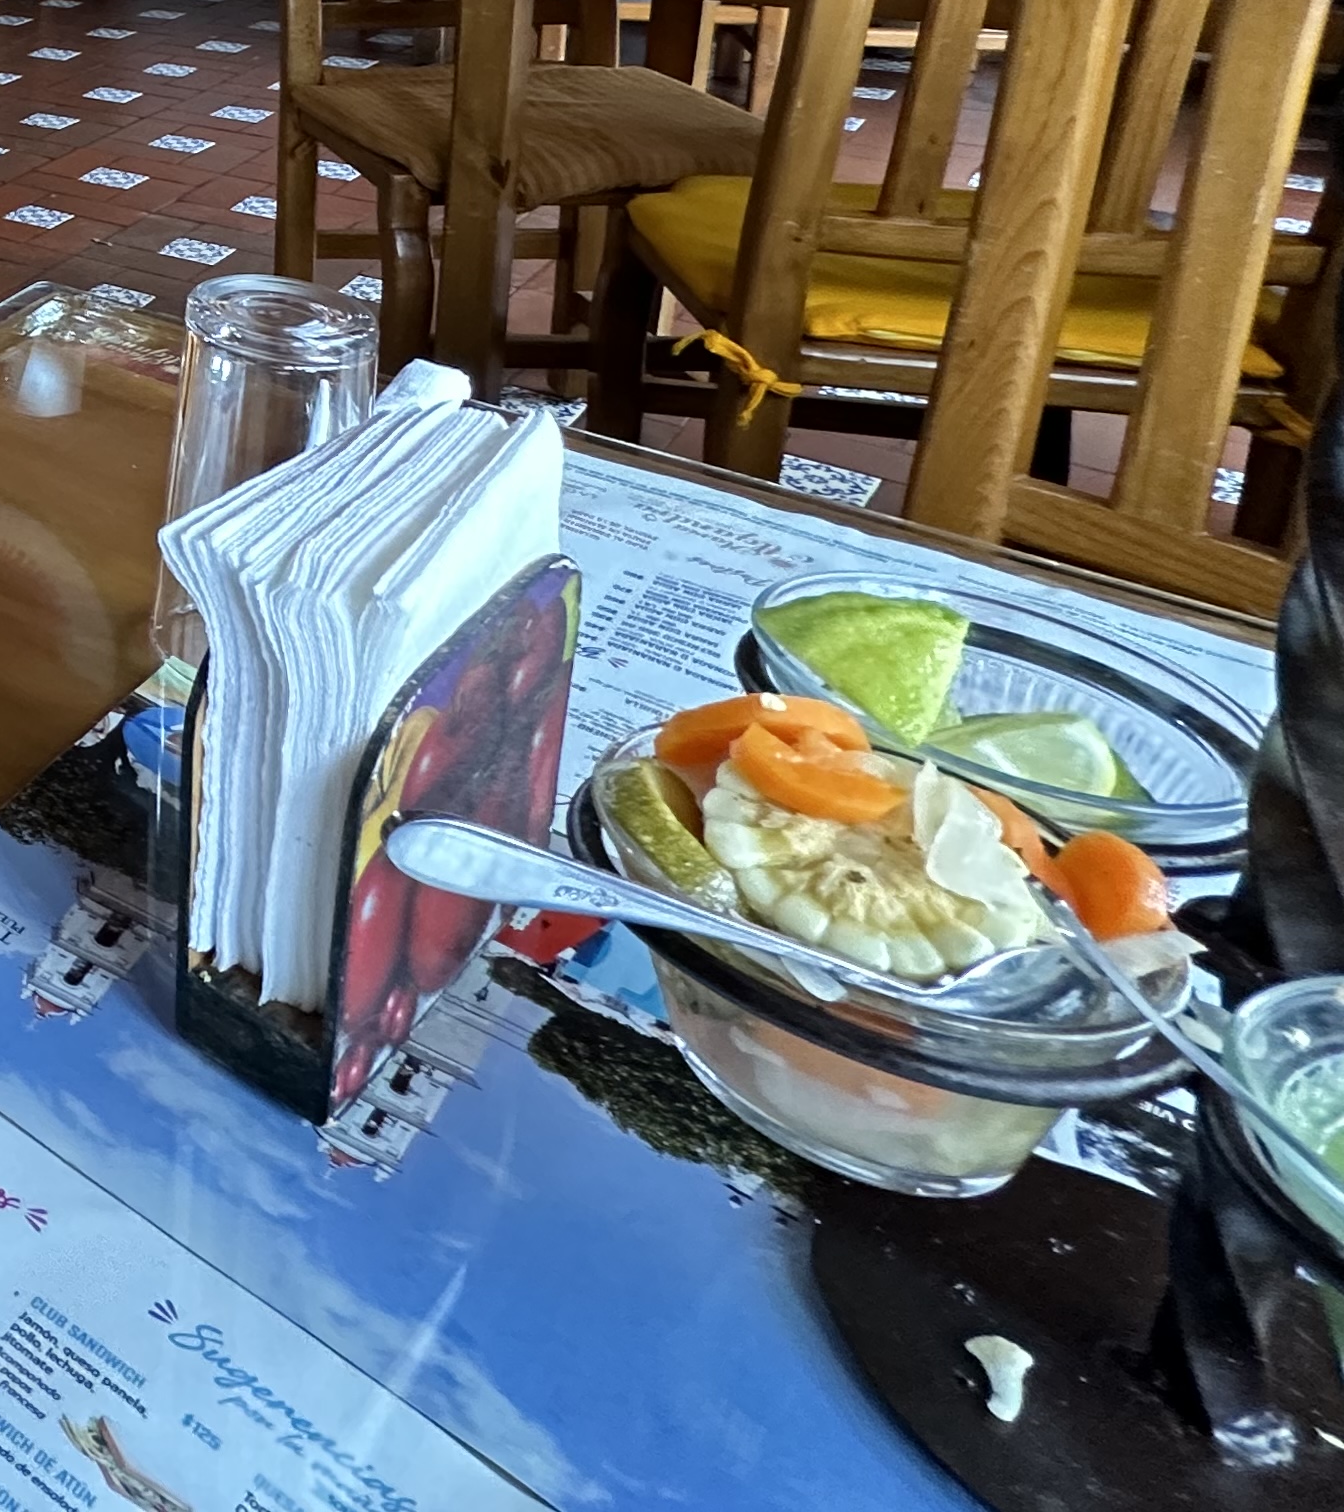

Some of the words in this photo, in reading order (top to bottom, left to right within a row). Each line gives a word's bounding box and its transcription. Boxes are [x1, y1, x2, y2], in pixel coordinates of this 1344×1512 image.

[1138, 1099, 1177, 1123] VIE
[0, 1331, 54, 1376] jitomate
[62, 1346, 101, 1378] queso
[30, 1296, 69, 1328] CLUB
[67, 1324, 147, 1389] SANDWICH
[181, 1413, 222, 1451] $125
[167, 1324, 418, 1512] Sugerencias
[14, 1463, 32, 1477] de
